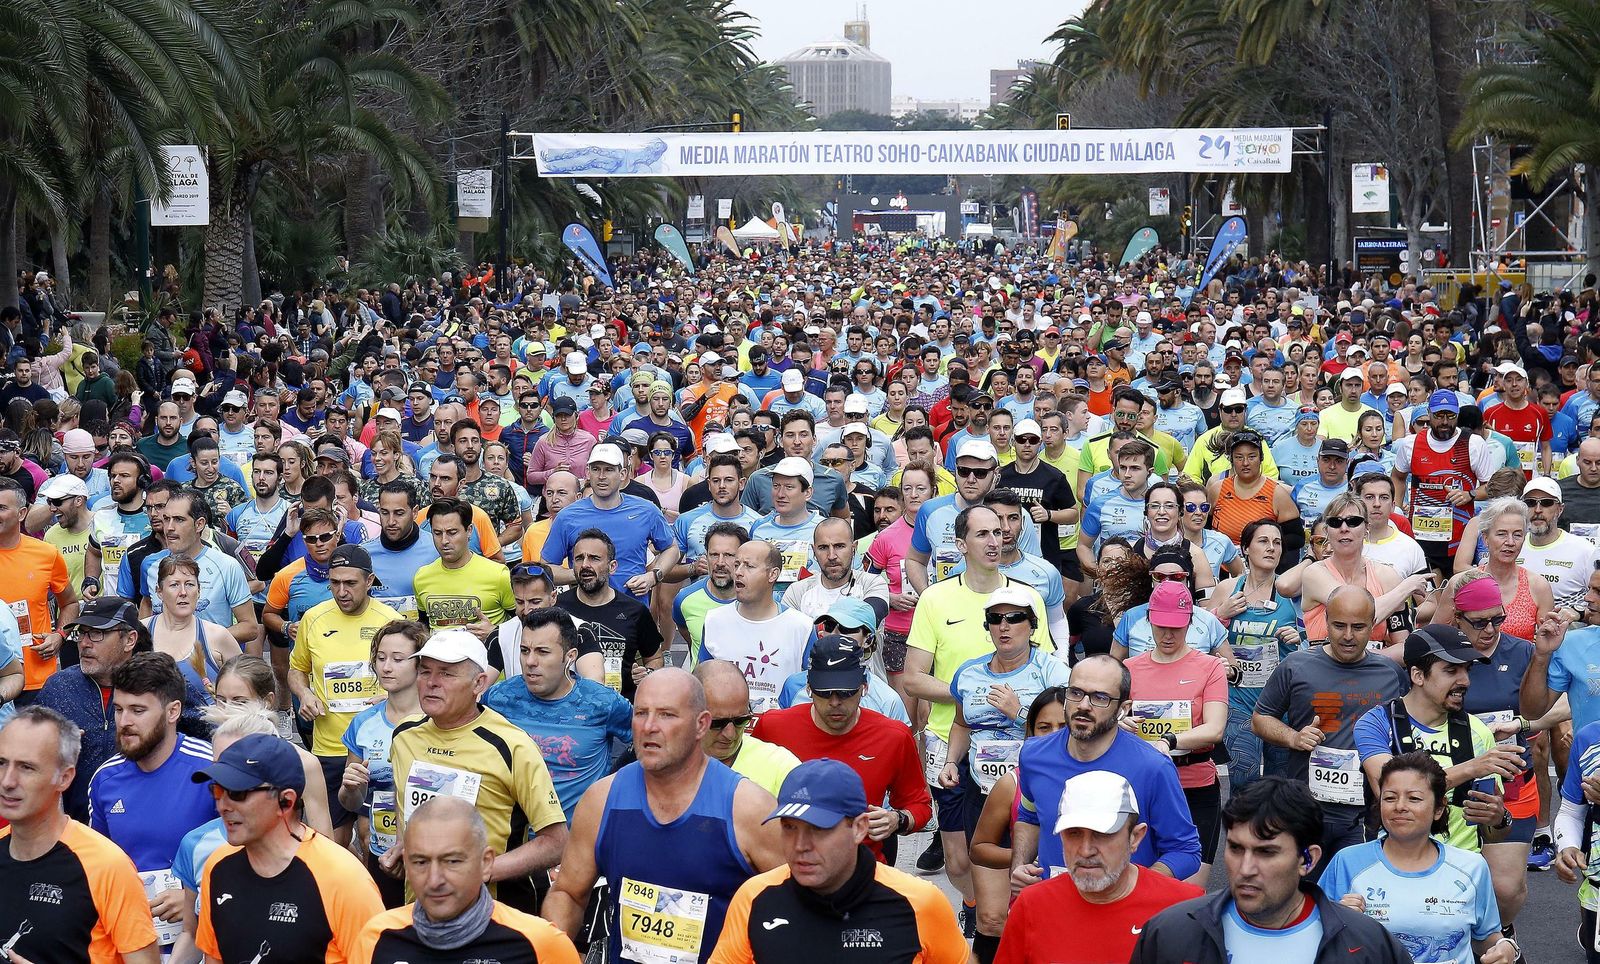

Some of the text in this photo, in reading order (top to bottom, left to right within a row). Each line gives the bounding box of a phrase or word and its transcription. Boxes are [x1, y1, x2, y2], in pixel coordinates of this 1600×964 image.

[1233, 132, 1282, 142] MEDIA MARATÓN
[680, 138, 1176, 165] MEDIA MARATÓN TEATRO SOHO-CAIXABANK CIUDAD DE MÁLAGA
[1246, 157, 1282, 166] CaixaBank
[1011, 487, 1043, 499] SPARTAN
[1418, 518, 1440, 528] 7129
[63, 545, 82, 555] RUN
[333, 682, 363, 694] 8058
[1141, 722, 1172, 736] 6202
[427, 747, 455, 757] KELME
[1314, 768, 1349, 785] 9420
[411, 790, 437, 807] 98
[626, 881, 654, 900] 7948
[1424, 896, 1439, 906] edp
[631, 913, 675, 938] 7948
